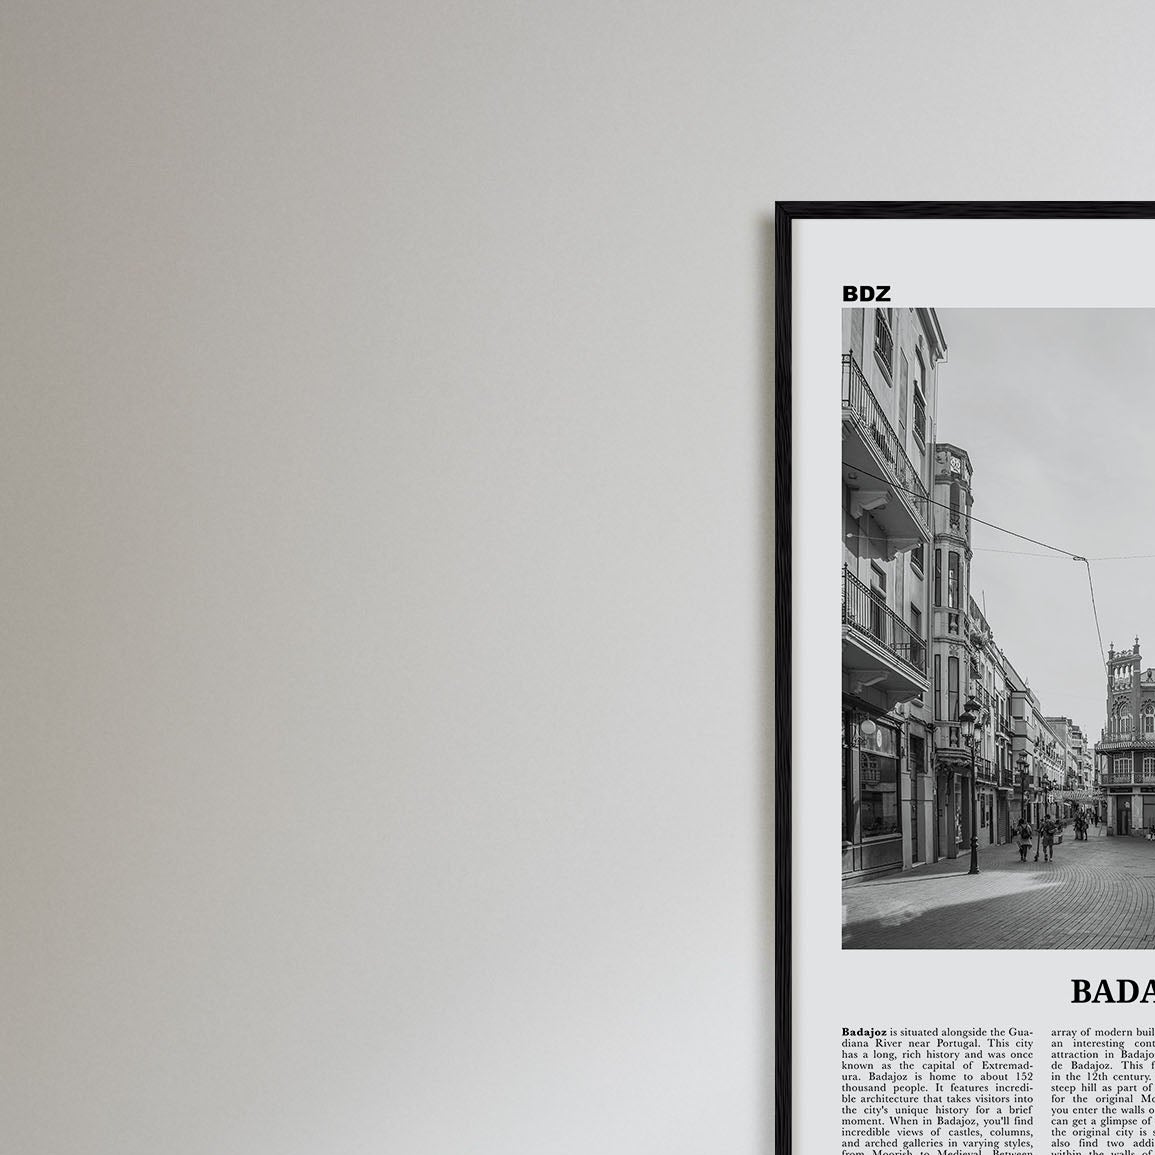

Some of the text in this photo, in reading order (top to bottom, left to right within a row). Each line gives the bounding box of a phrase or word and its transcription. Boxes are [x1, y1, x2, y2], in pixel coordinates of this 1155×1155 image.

[842, 285, 892, 303] BDZ
[841, 1028, 1034, 1039] Badajoz is situated alongside the Gua-
[1050, 1030, 1078, 1039] array
[1080, 1028, 1092, 1036] of
[1094, 1028, 1133, 1036] modern
[841, 1039, 869, 1048] diana
[875, 1039, 903, 1048] River
[936, 1039, 981, 1050] Portugal.
[986, 1039, 1010, 1048] This
[1015, 1039, 1034, 1050] city
[1073, 1039, 1126, 1050] interesting
[1050, 1050, 1099, 1059] attraction
[1104, 1050, 1115, 1059] in
[841, 1061, 874, 1070] known
[899, 1061, 915, 1070] the
[921, 1061, 955, 1072] capital
[962, 1061, 974, 1070] of
[981, 1061, 1034, 1070] Extremad-
[1050, 1061, 1063, 1070] de
[1071, 1061, 1113, 1072] Badajoz.
[1120, 1061, 1144, 1070] This
[868, 1072, 908, 1083] Badajoz
[914, 1072, 923, 1081] is
[929, 1072, 957, 1081] home
[963, 1072, 974, 1081] to
[980, 1072, 1009, 1081] about
[1016, 1072, 1034, 1081] 152
[841, 1083, 1034, 1094] thousand people. It features incredi-
[841, 1094, 1034, 1103] ble architecture that takes visitors into
[1051, 1094, 1066, 1103] for
[1072, 1094, 1089, 1103] the
[1095, 1094, 1134, 1106] original
[841, 1117, 1034, 1128] moment. When in Badajoz, you'll find
[841, 1128, 1034, 1139] incredible views of castles, columns,
[841, 1139, 1034, 1150] and arched galleries in varying styles,
[1050, 1139, 1071, 1147] also
[1078, 1139, 1099, 1147] find
[1106, 1139, 1125, 1147] two
